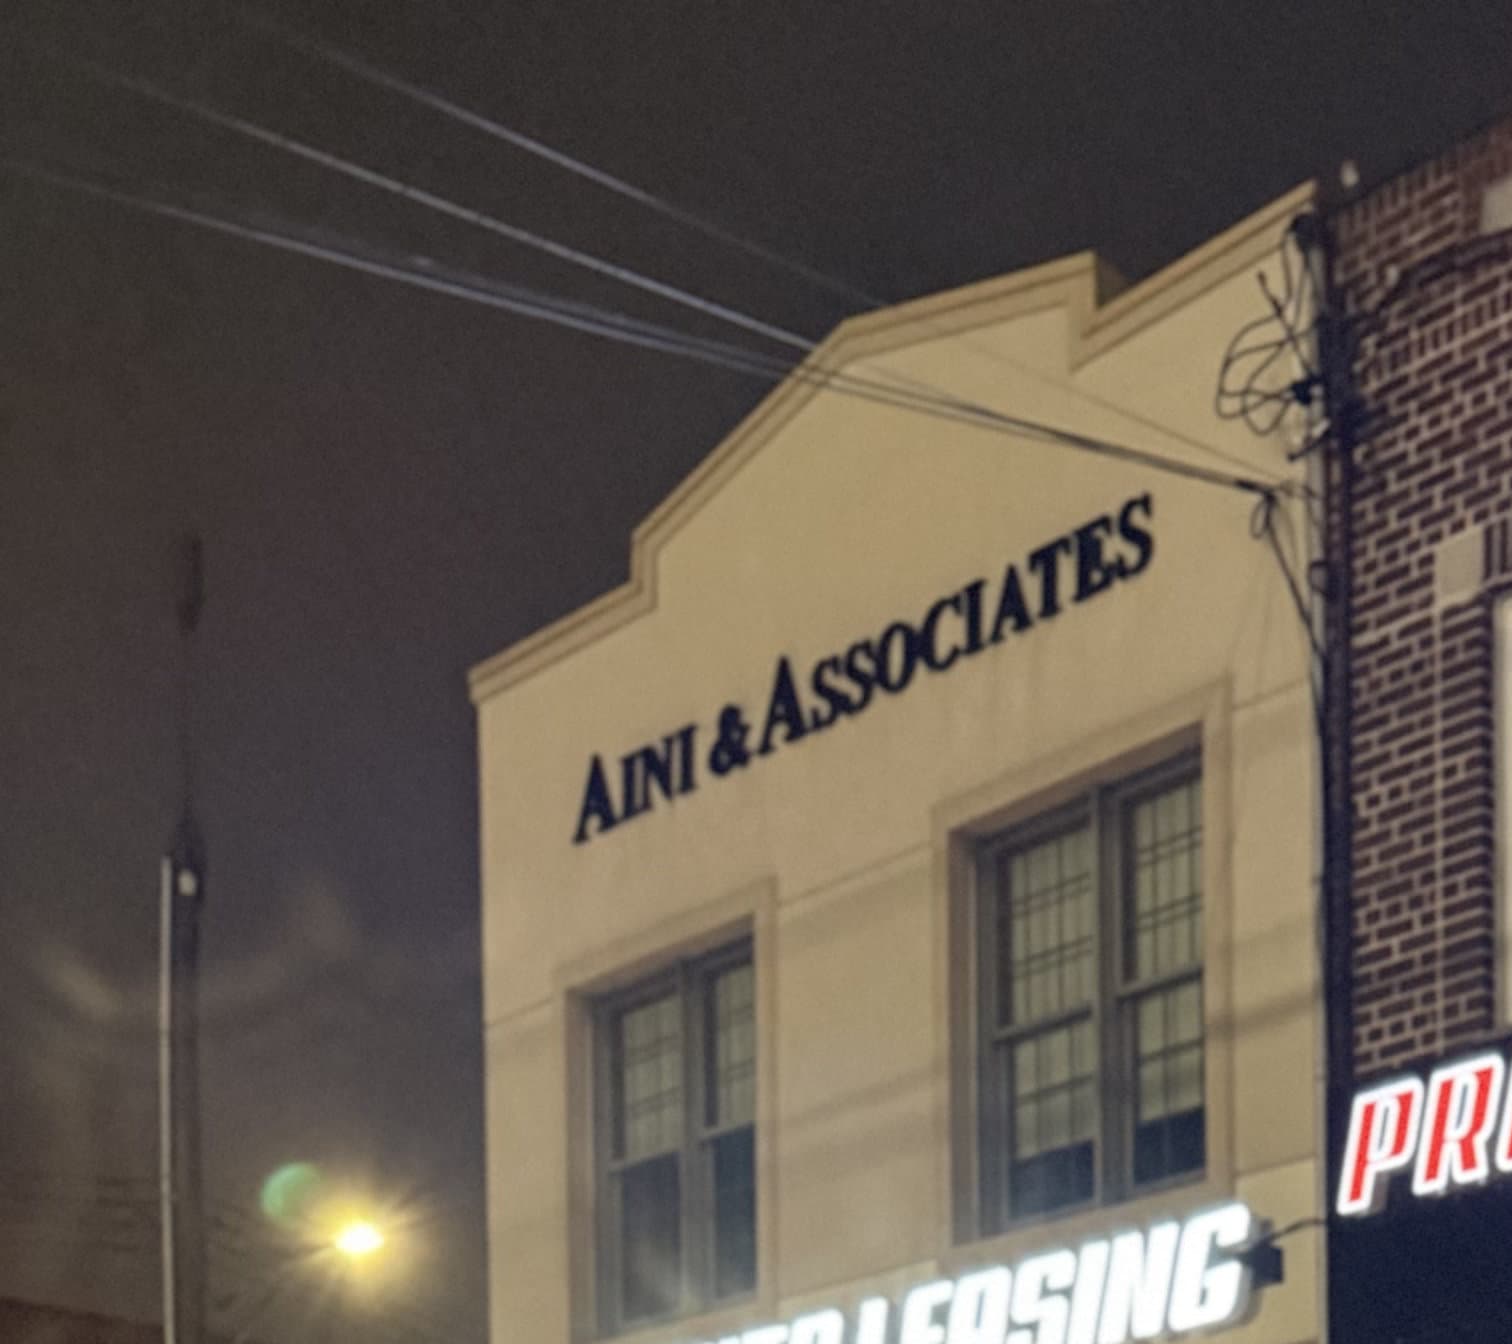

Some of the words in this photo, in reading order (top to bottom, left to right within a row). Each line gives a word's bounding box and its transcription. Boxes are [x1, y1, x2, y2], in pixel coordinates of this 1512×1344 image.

[571, 722, 698, 845] AINI
[706, 704, 753, 778] &
[757, 493, 1155, 755] ASSOCIATES
